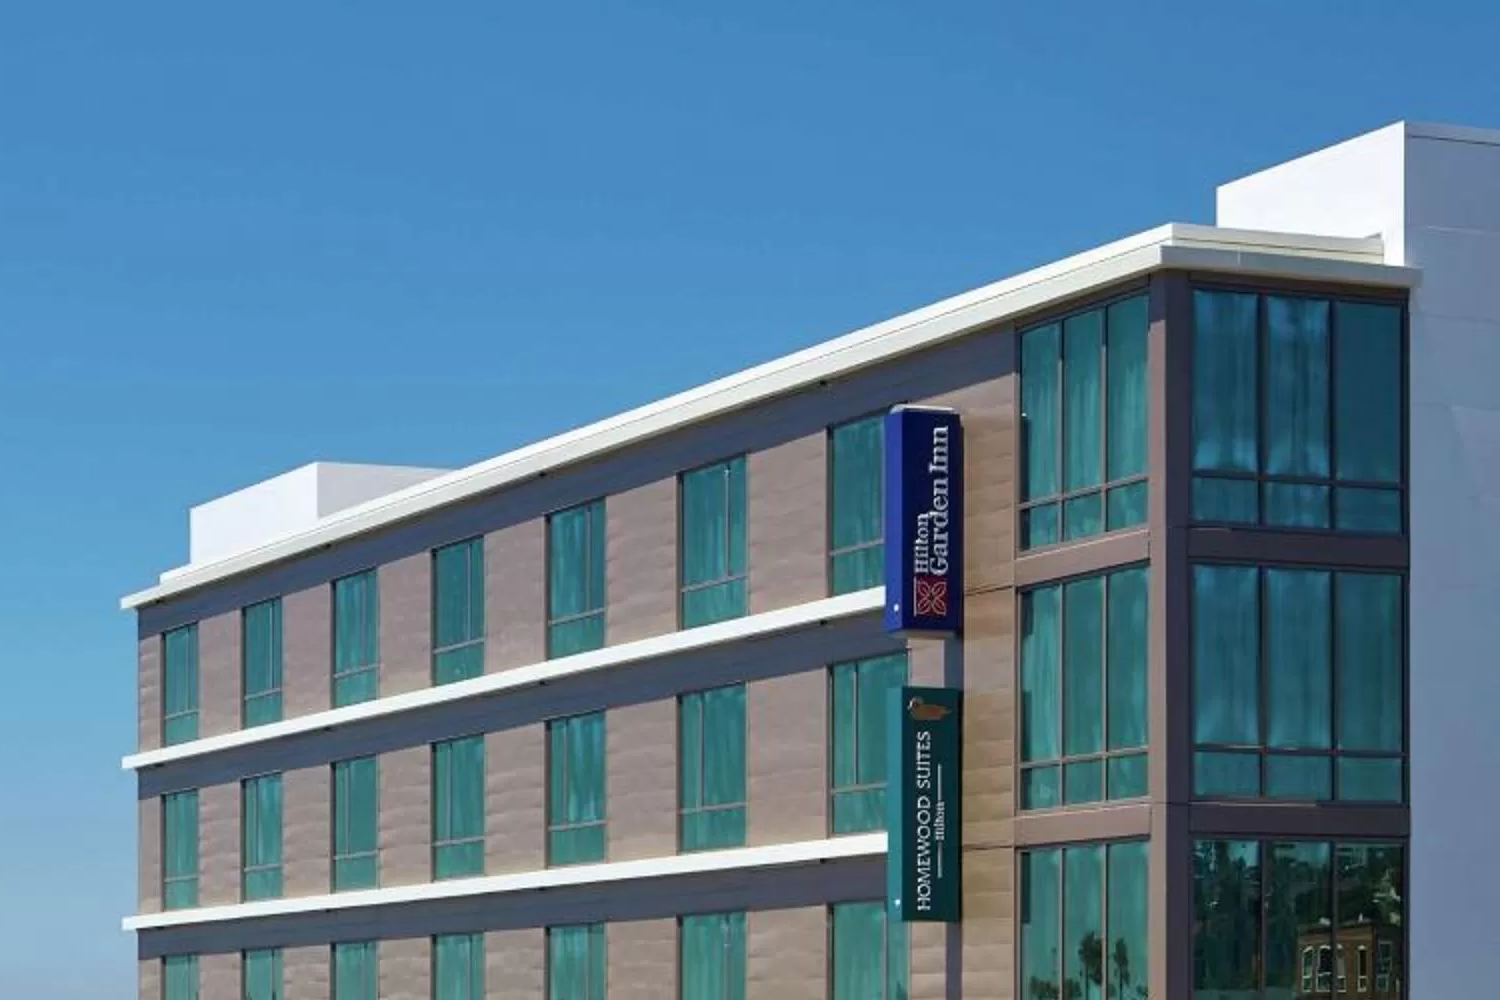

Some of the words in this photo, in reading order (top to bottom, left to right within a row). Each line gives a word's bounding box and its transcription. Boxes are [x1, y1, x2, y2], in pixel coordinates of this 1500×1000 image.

[927, 425, 949, 475] Inn
[913, 512, 929, 575] Hilton
[927, 478, 949, 577] Garden
[916, 730, 932, 790] SUITES
[933, 801, 945, 841] Hilton
[916, 795, 932, 912] HOMEWOOD
